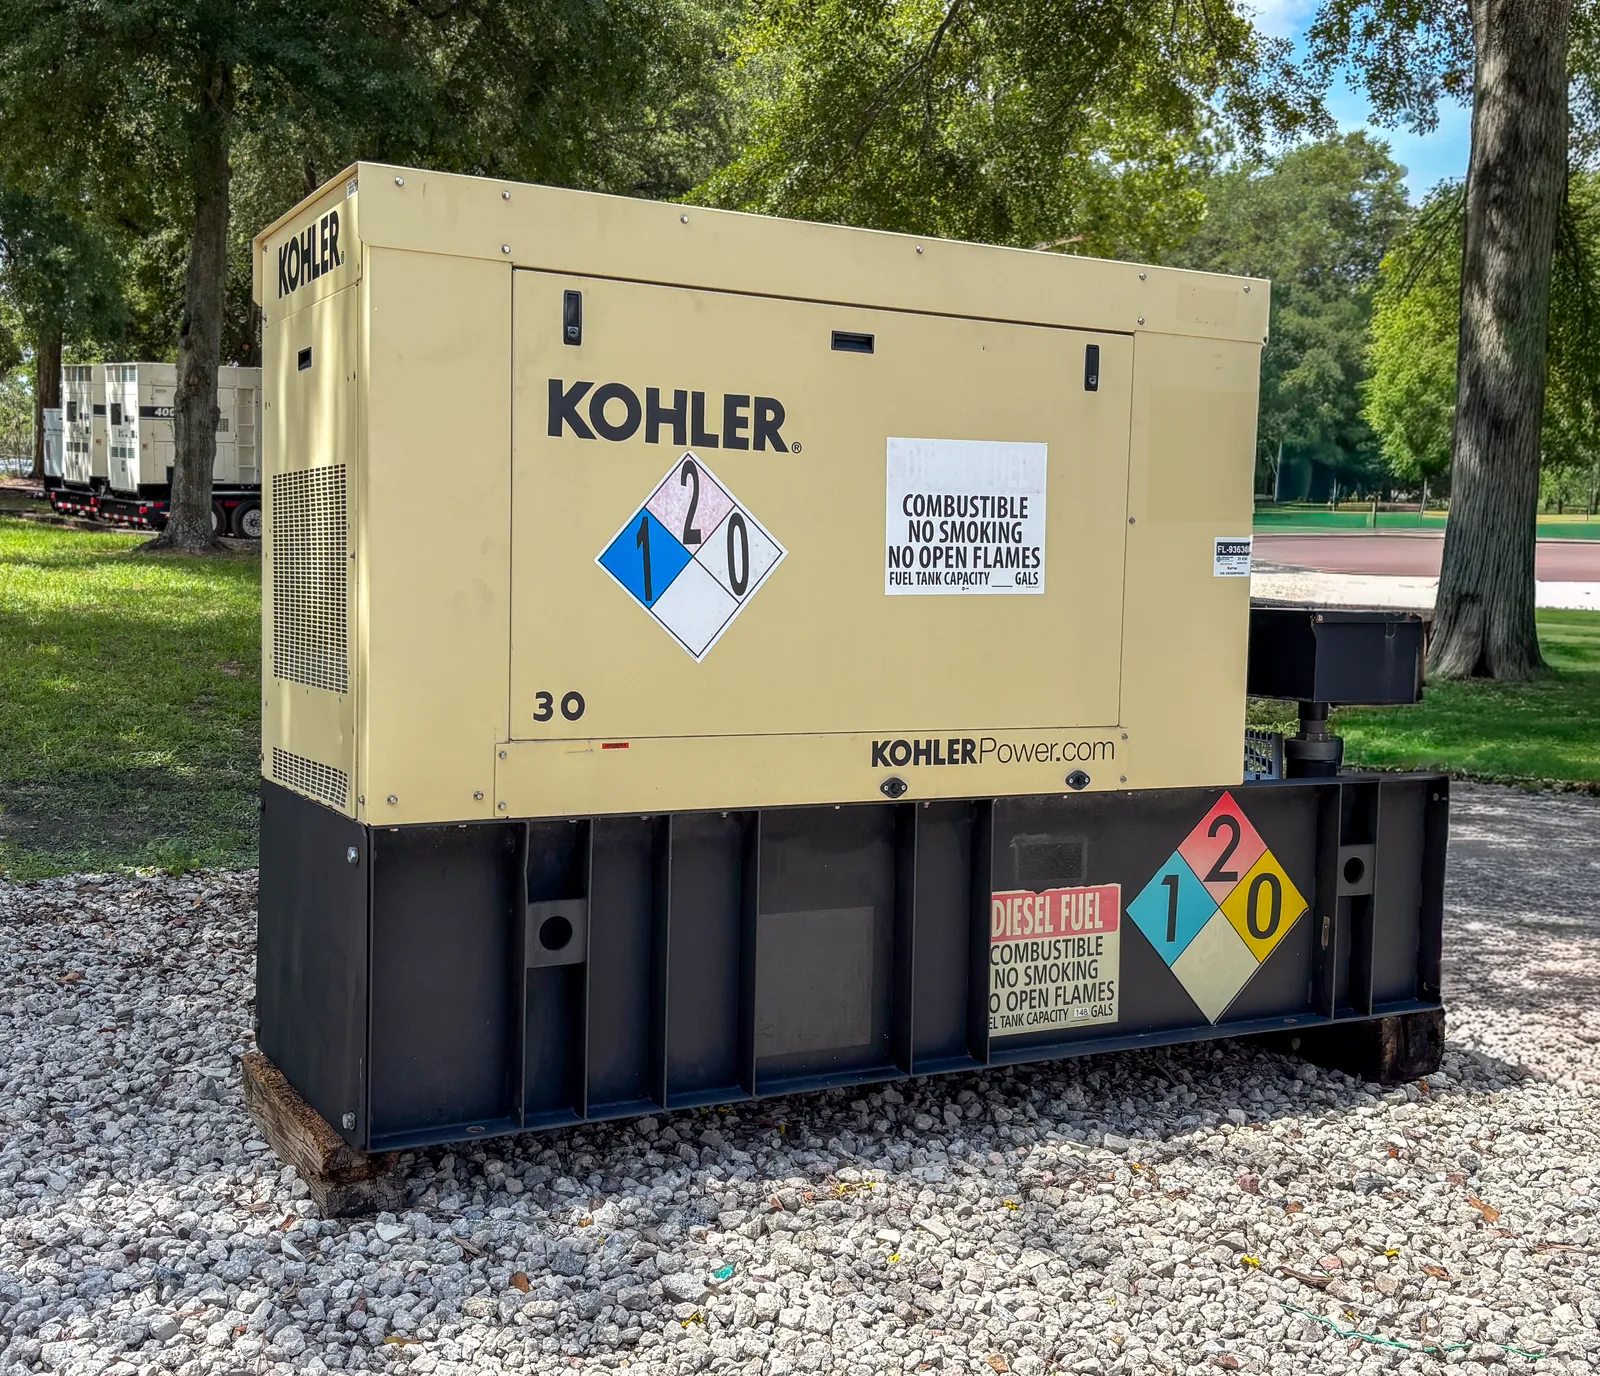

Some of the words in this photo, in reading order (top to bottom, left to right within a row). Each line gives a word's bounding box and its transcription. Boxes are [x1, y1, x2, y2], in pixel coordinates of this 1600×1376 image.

[680, 460, 702, 545] 2
[902, 493, 1029, 519] COMBUSTIBLE
[908, 520, 935, 543] NO
[939, 520, 1023, 544] SMOKING
[636, 516, 653, 601] 1
[726, 512, 750, 597] 0
[888, 545, 914, 569] NO
[919, 546, 968, 569] OPEN
[973, 546, 1041, 569] FLAMES
[889, 571, 914, 586] FUEL
[915, 571, 943, 586] TANK
[944, 571, 991, 586] CAPACITY
[1015, 571, 1039, 586] GALS
[532, 690, 586, 722] 30
[871, 737, 1115, 767] KOHLERPower.com
[1203, 814, 1241, 882] 2
[991, 895, 1054, 938] DIESEL
[1061, 892, 1104, 932] FUEL
[1160, 874, 1179, 943] 1
[1246, 872, 1282, 940] 0
[990, 936, 1104, 966] COMBUSTIBLE
[994, 967, 1019, 990] NO
[1024, 959, 1099, 986] SMOKING
[989, 993, 1001, 1014] O
[1006, 987, 1049, 1012] OPEN
[1054, 980, 1115, 1007] FLAMES
[1000, 1013, 1025, 1028] TANK
[1026, 1008, 1069, 1026] CAPACITY
[1091, 1003, 1113, 1018] GALS
